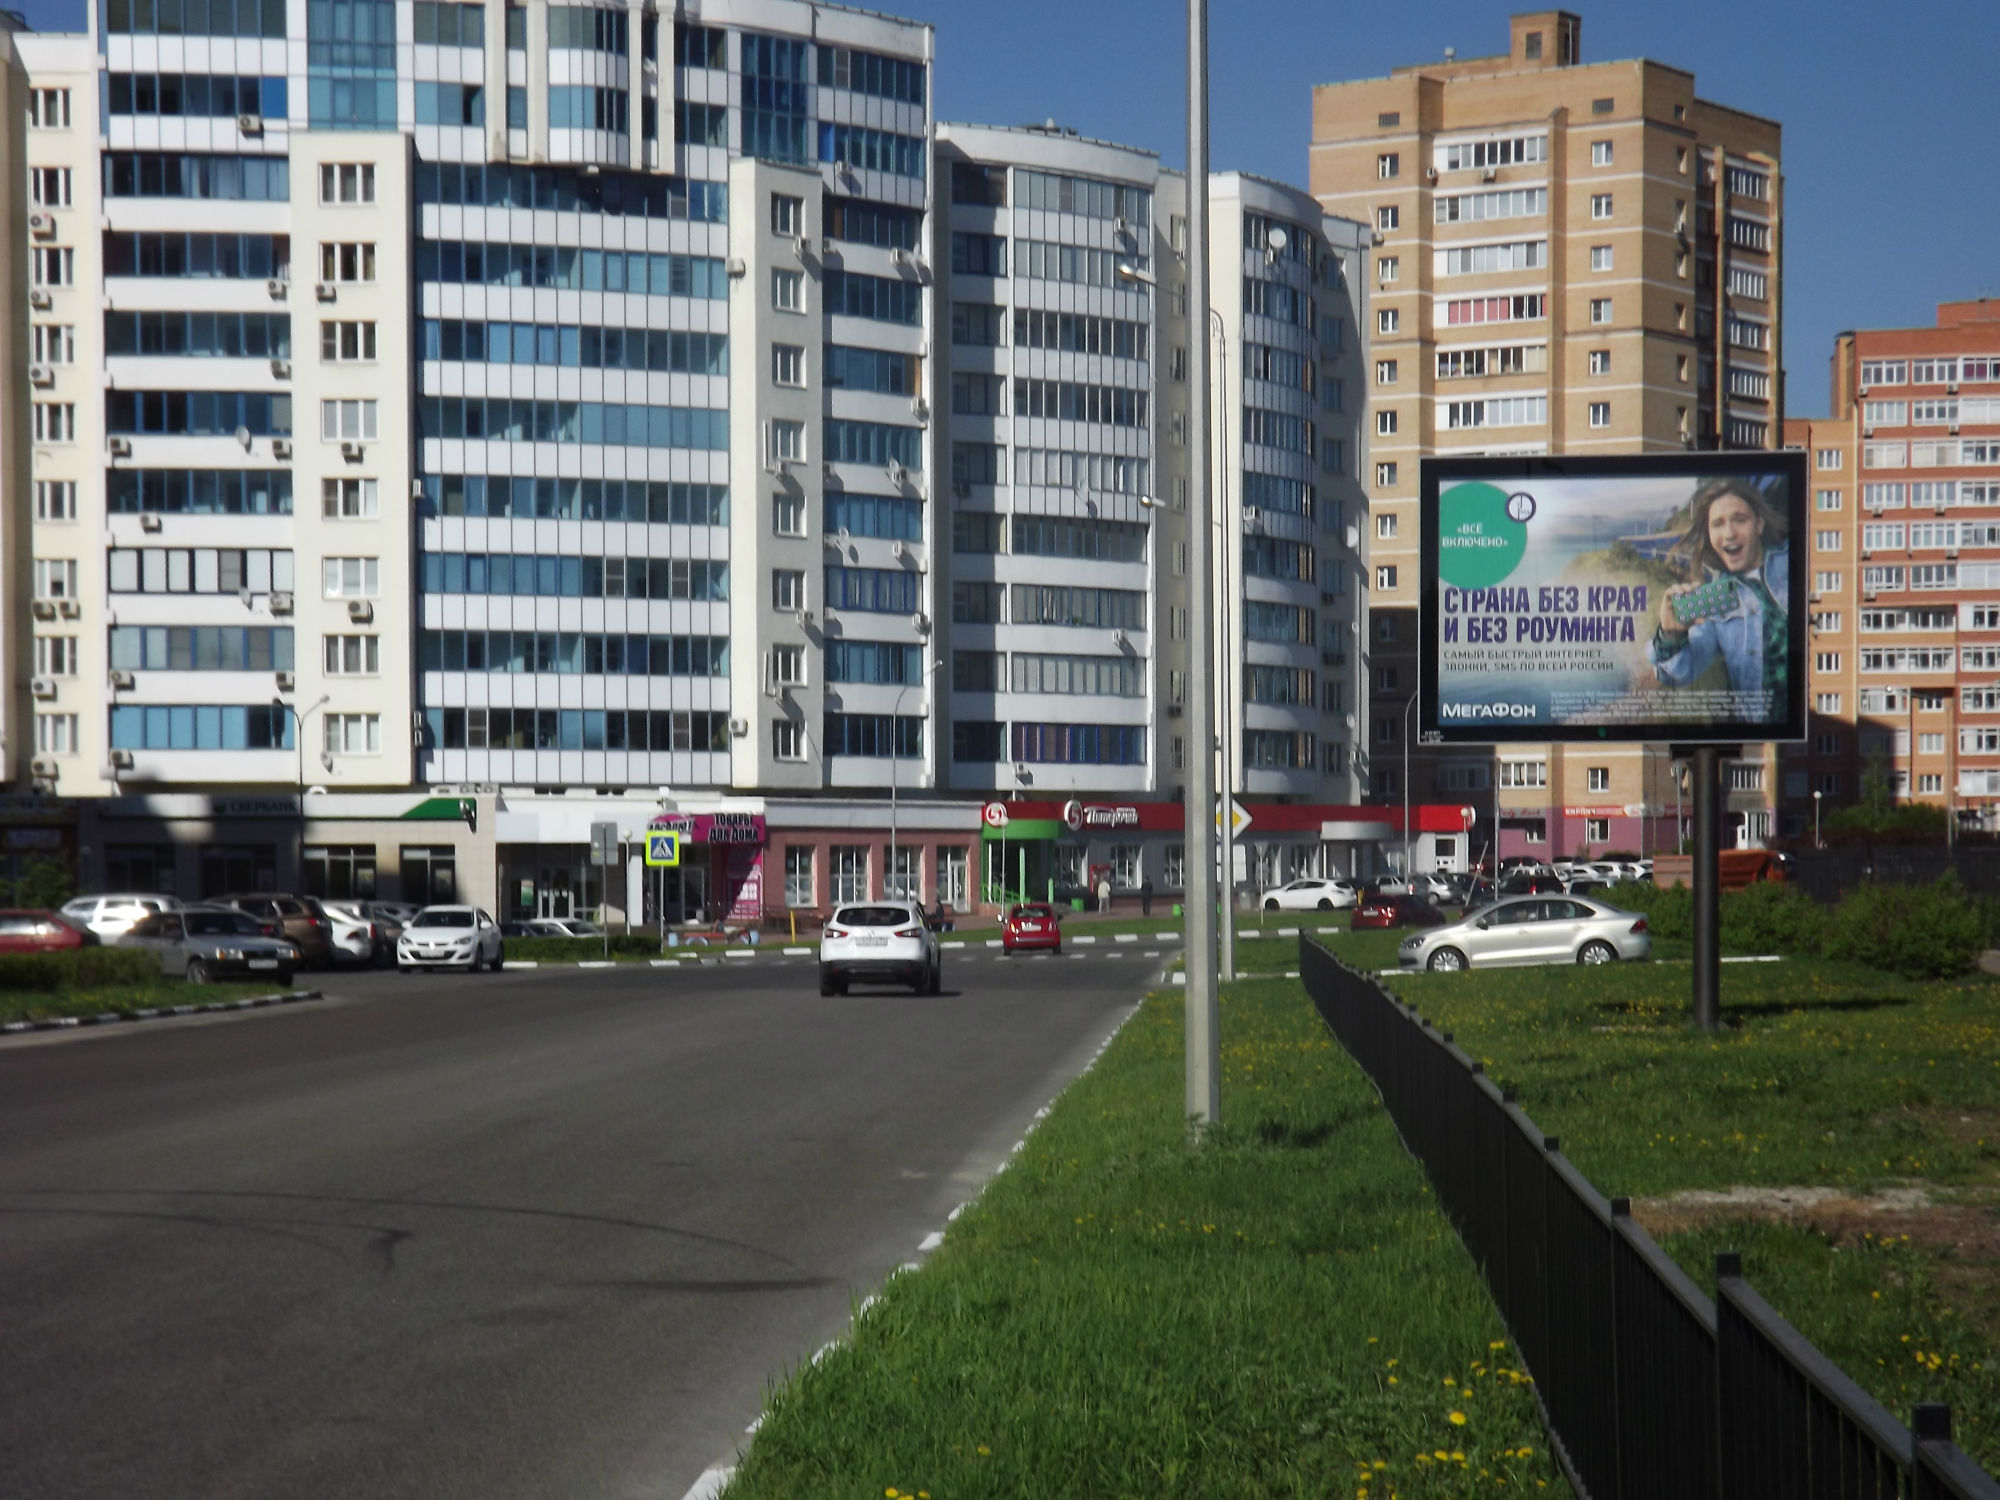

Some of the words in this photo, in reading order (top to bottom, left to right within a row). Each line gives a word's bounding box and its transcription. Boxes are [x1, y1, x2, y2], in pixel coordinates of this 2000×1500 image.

[1444, 586, 1530, 613] СТРАНА
[1538, 586, 1579, 613] БЕЗ
[1588, 586, 1647, 612] КРАЯ
[1444, 617, 1459, 643] И
[1467, 617, 1508, 643] БЕЗ
[1516, 616, 1635, 643] РОУМИНГА
[1443, 649, 1485, 660] САМЫЙ
[1488, 649, 1542, 660] БЫСТРЫЙ
[1494, 661, 1517, 671] SMS
[1520, 661, 1535, 671] ПО
[1538, 660, 1567, 671] ВСЕЙ
[1570, 661, 1614, 671] РОССИИ
[714, 813, 752, 826] ТОВАРЫ
[708, 827, 728, 843] ДЛЯ
[730, 827, 758, 843] ДОМА
